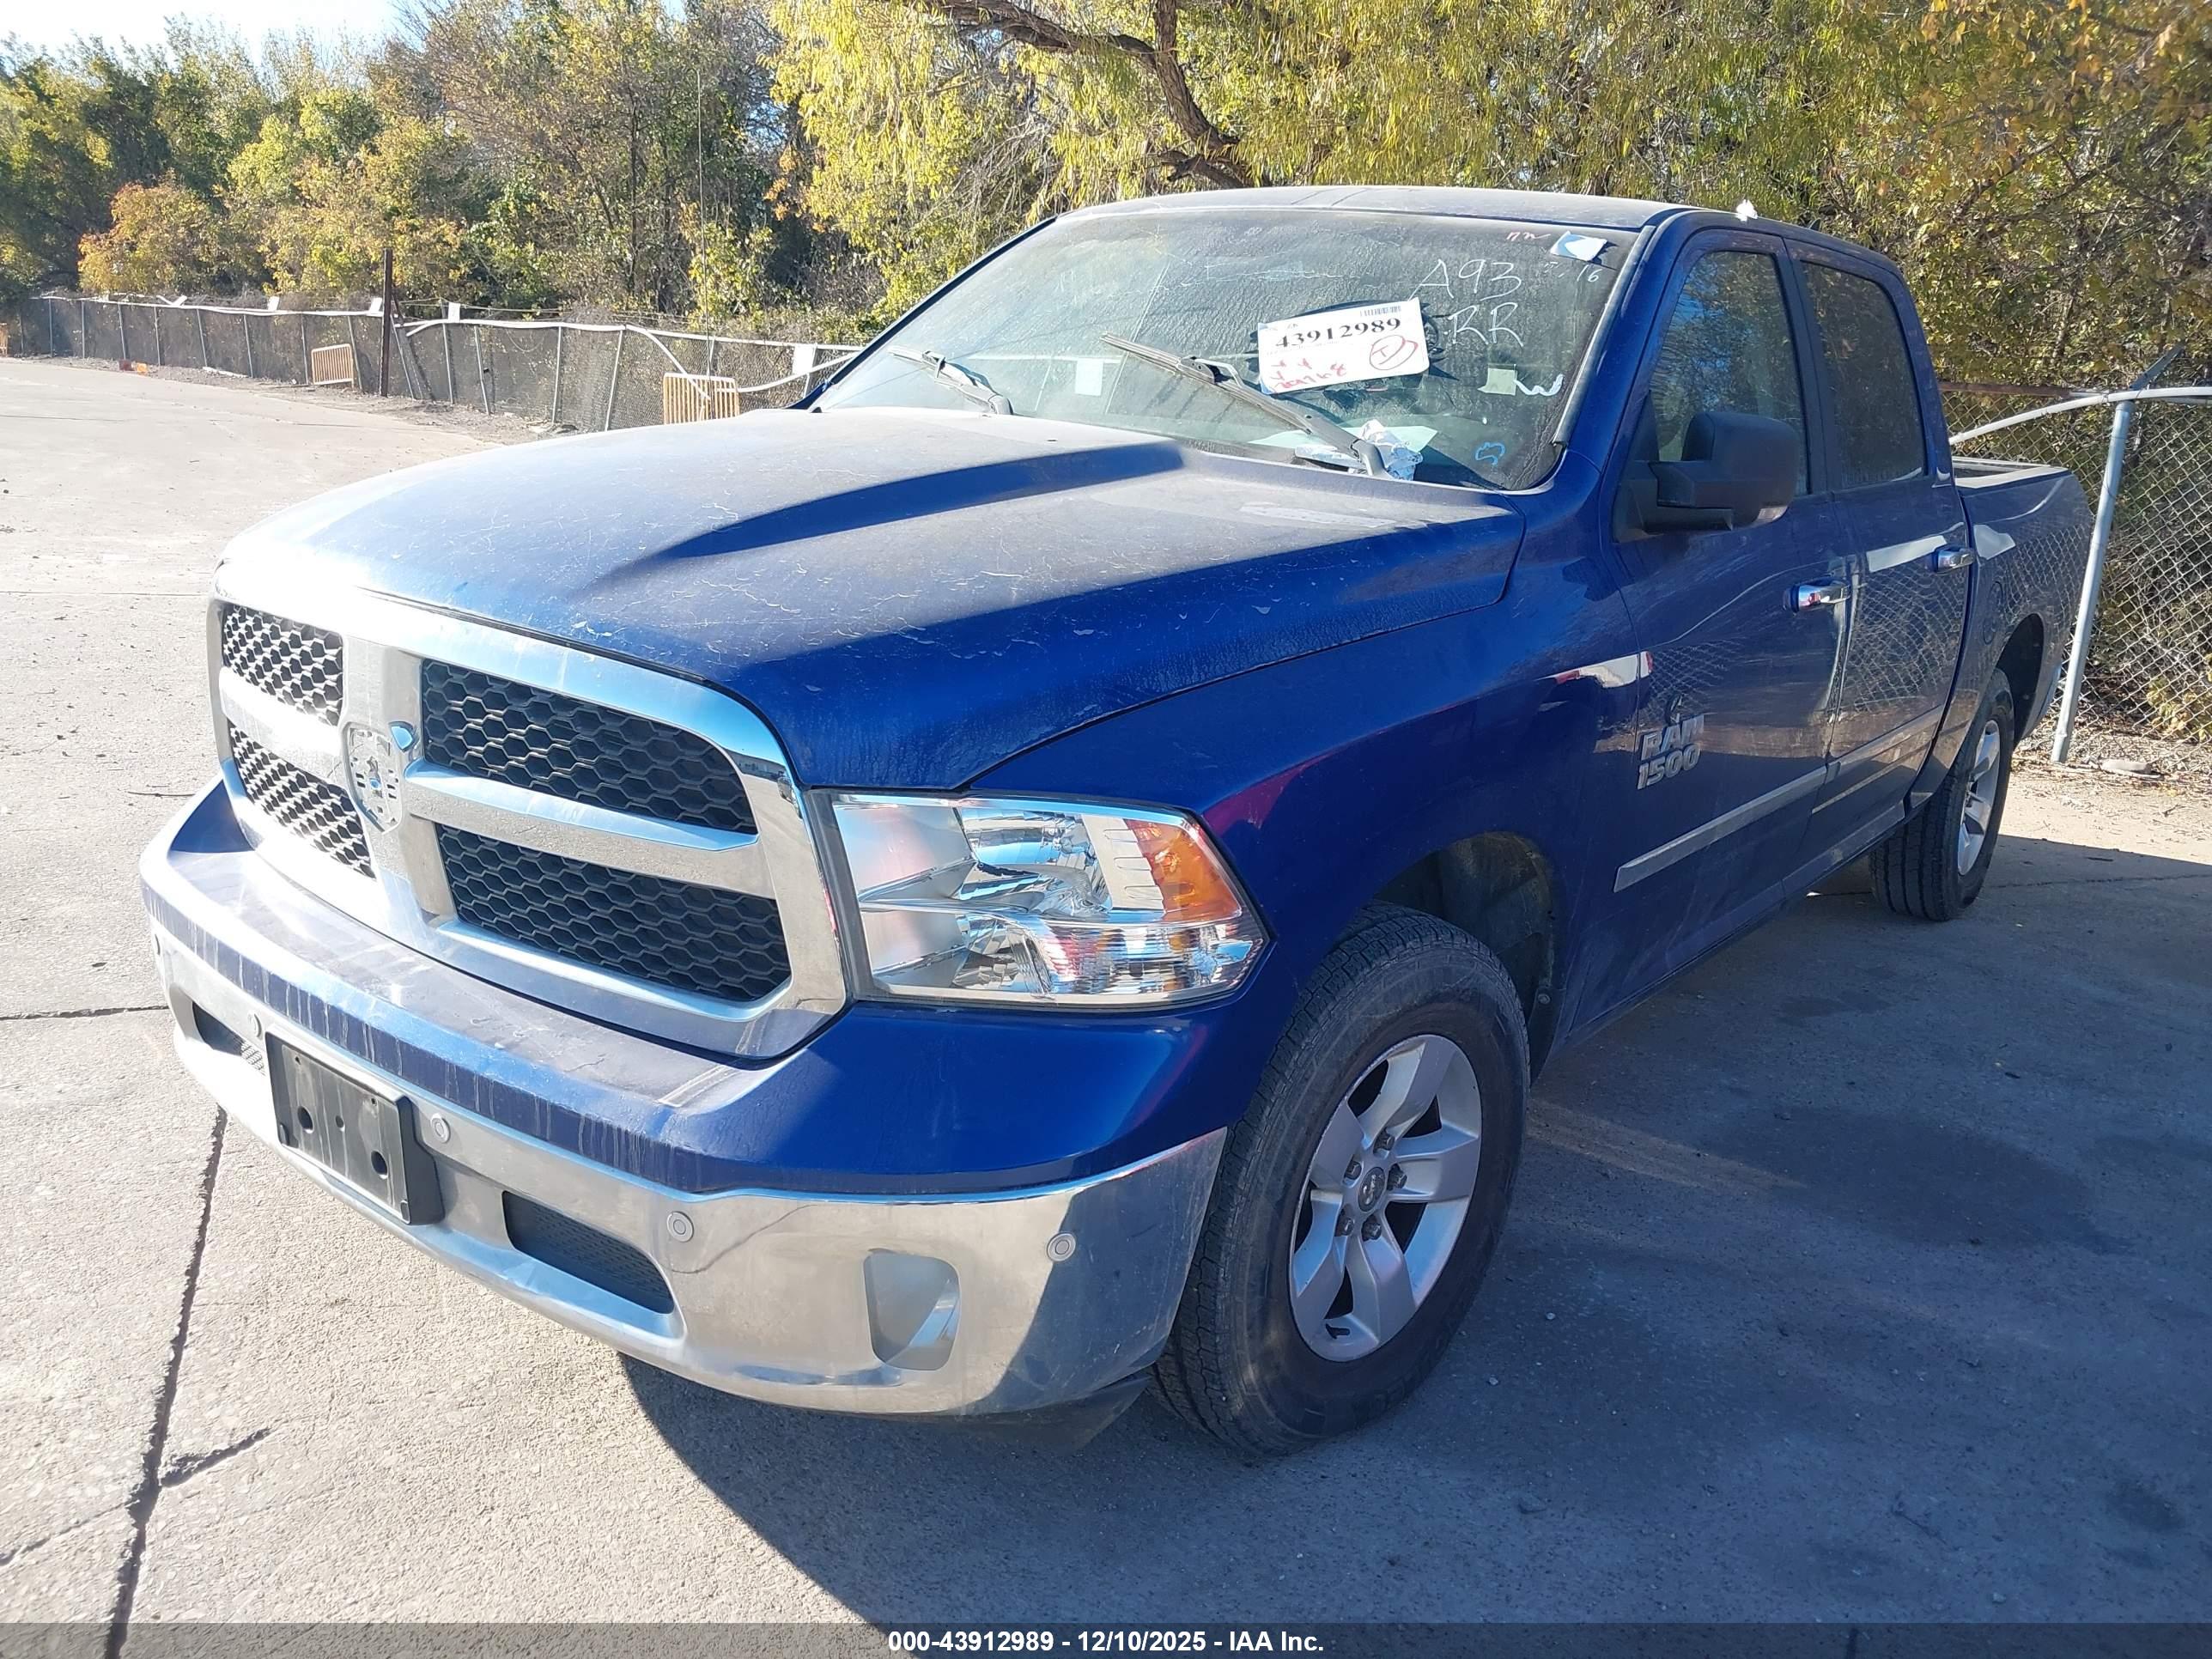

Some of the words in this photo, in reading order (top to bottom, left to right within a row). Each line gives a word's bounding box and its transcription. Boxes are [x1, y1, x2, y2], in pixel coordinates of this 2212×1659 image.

[1408, 258, 1522, 301] A93
[1275, 317, 1403, 349] 43912989
[1641, 714, 1705, 761] RAM
[1638, 744, 1702, 790] 1500
